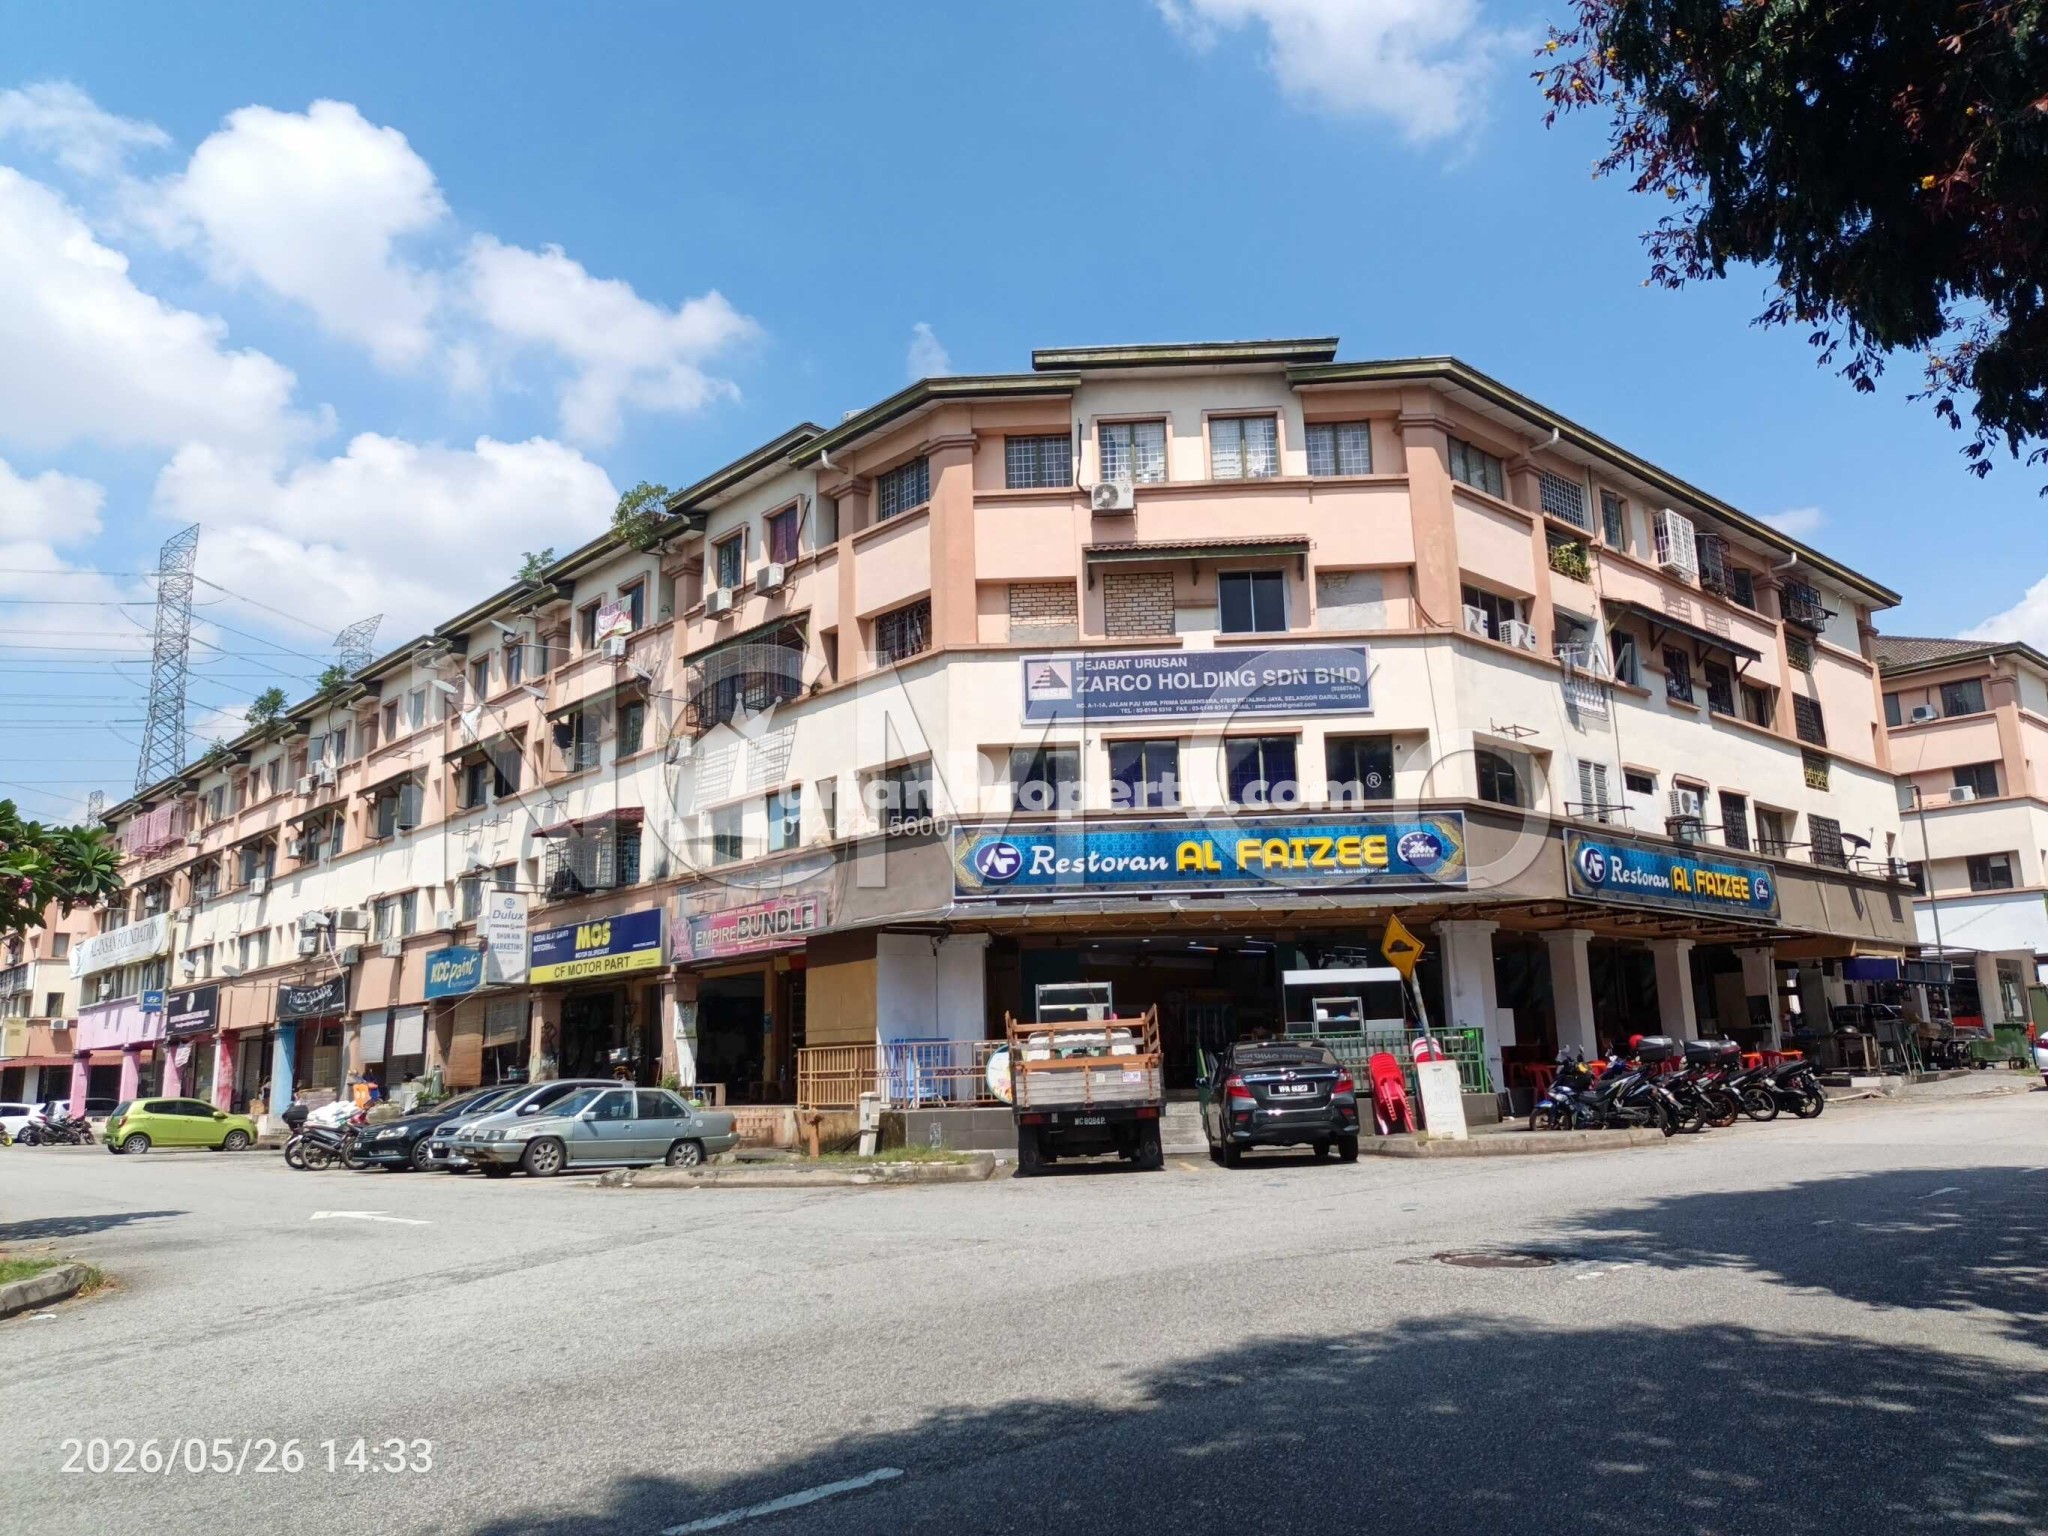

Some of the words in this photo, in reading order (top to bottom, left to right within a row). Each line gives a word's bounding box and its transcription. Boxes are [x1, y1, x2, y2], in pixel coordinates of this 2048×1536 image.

[1076, 659, 1131, 671] PEJABAT
[1134, 657, 1188, 669] URUSAN
[1076, 674, 1152, 693] ZARCO
[1157, 671, 1257, 690] HOLDING
[1262, 668, 1311, 687] SDN
[1314, 667, 1361, 685] BHD
[1029, 844, 1169, 875] Restoran
[1176, 839, 1222, 872] AL
[1236, 834, 1389, 870] FAIZEE
[1610, 855, 1670, 889] Restoran
[1671, 865, 1692, 893] AL
[1694, 869, 1751, 900] FAIZEE
[492, 909, 525, 920] Dulux
[695, 926, 737, 949] EMPIRE
[737, 904, 815, 942] BUNDLE
[491, 942, 524, 951] MARKETING
[575, 921, 611, 950] MOS
[430, 960, 451, 984] KCC
[447, 953, 478, 989] paint
[553, 966, 566, 979] CF
[568, 960, 602, 976] MOTOR
[604, 955, 631, 971] PART
